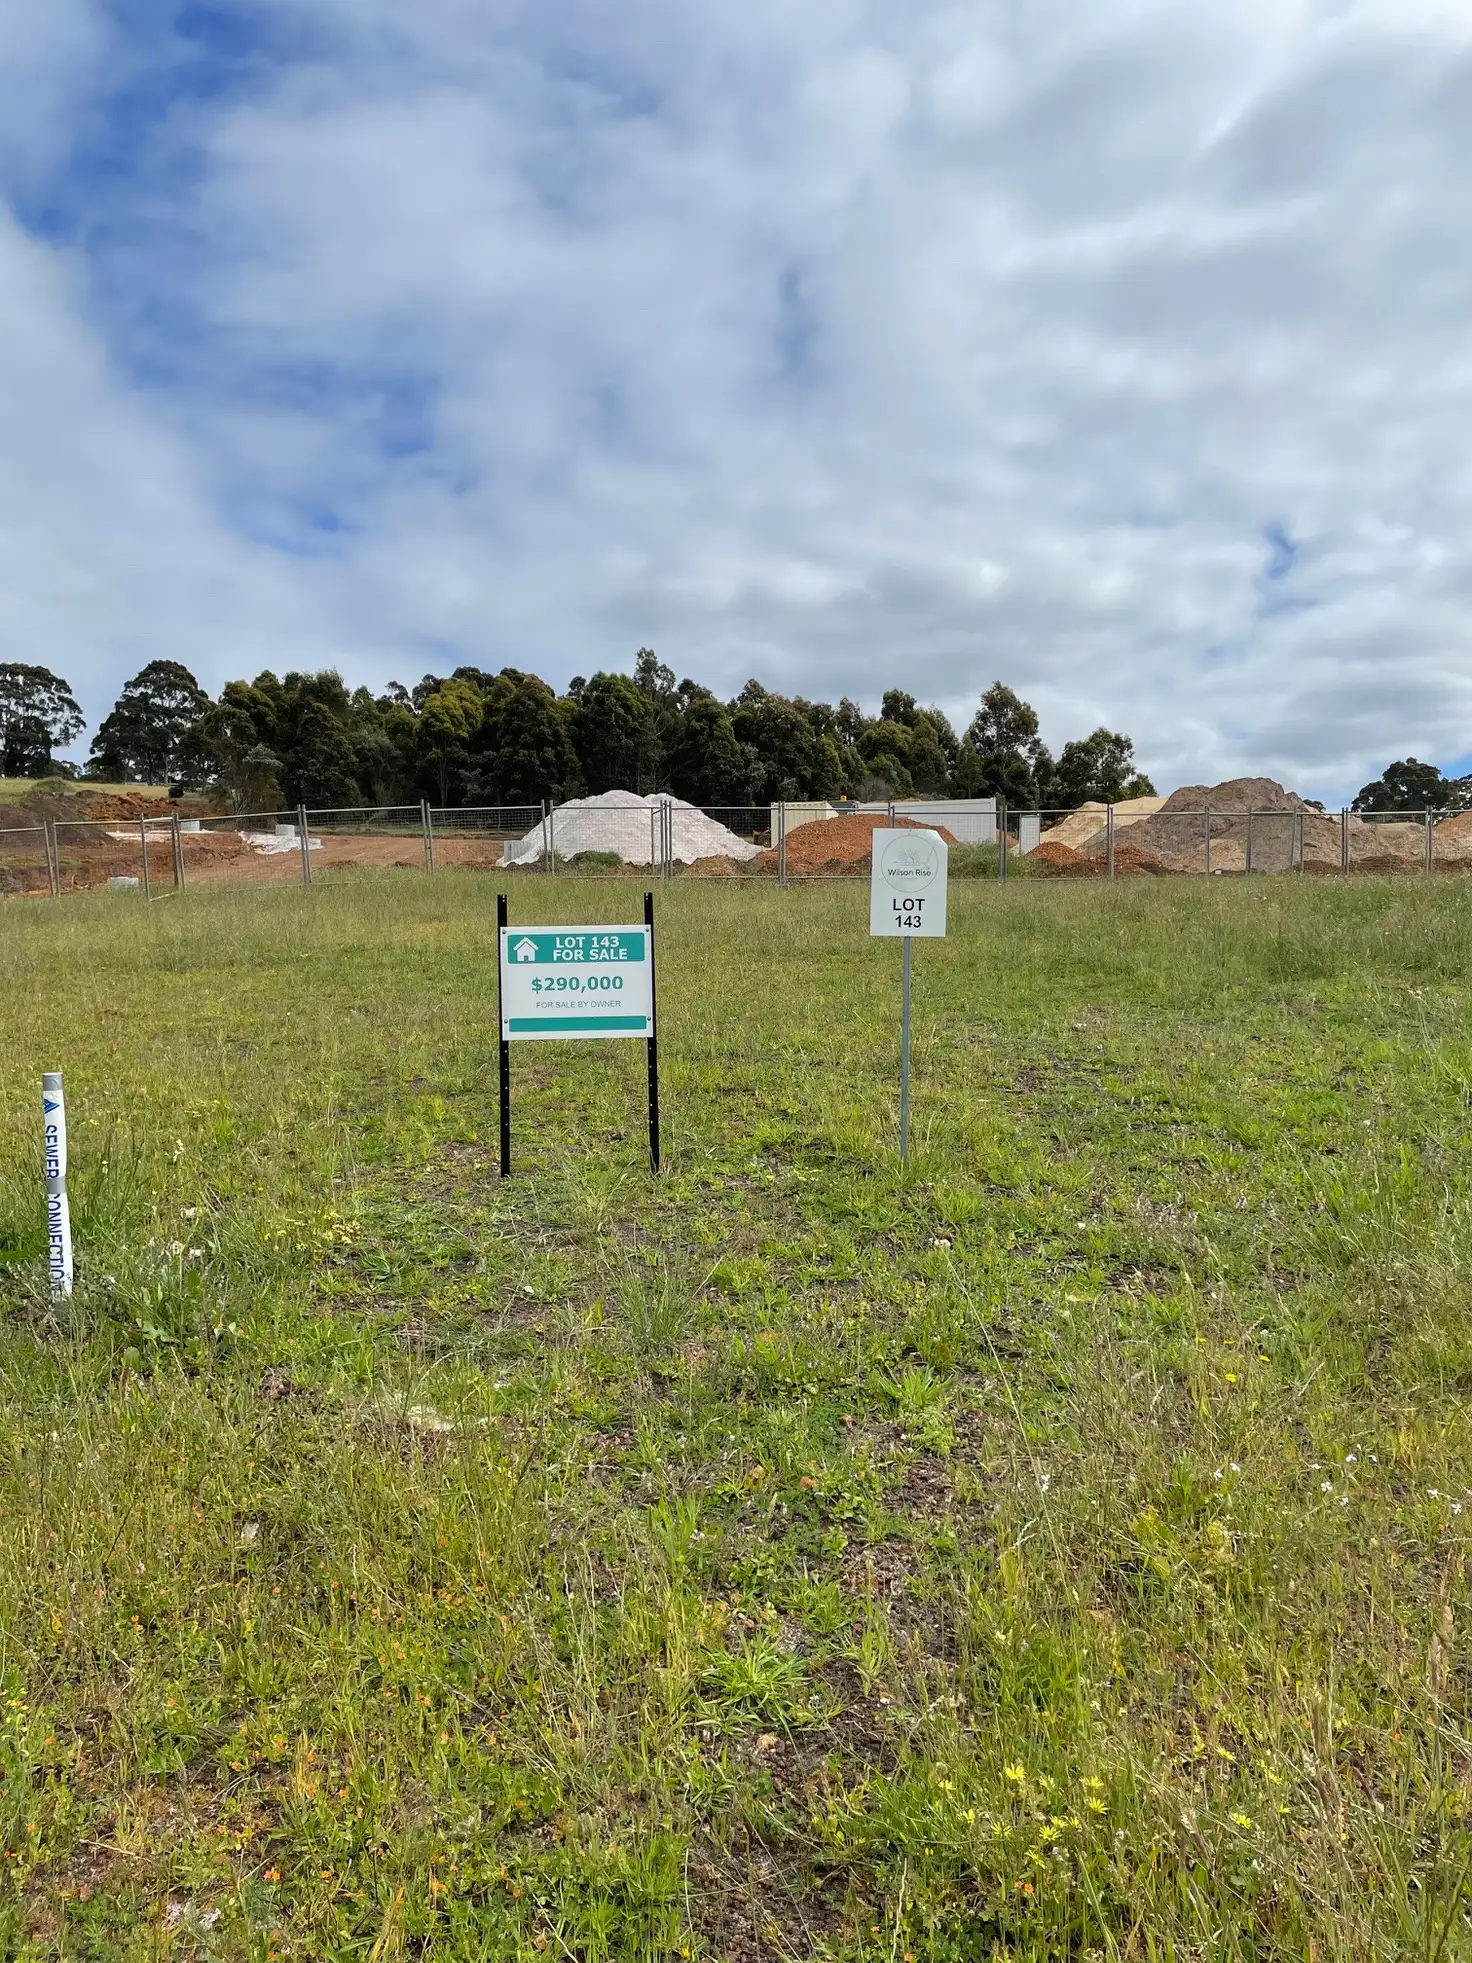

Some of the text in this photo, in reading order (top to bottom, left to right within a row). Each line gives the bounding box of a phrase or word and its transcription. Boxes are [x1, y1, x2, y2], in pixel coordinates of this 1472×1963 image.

[888, 868, 931, 877] Wilson Rise
[893, 898, 925, 911] LOT
[895, 915, 922, 928] 143
[555, 936, 620, 949] LOT 143
[553, 948, 628, 961] FOR SALE
[531, 976, 623, 994] $290,000
[536, 1001, 553, 1009] FOR
[555, 1001, 576, 1009] SALE
[590, 1000, 621, 1008] OWNER
[45, 1124, 60, 1179] SEWER
